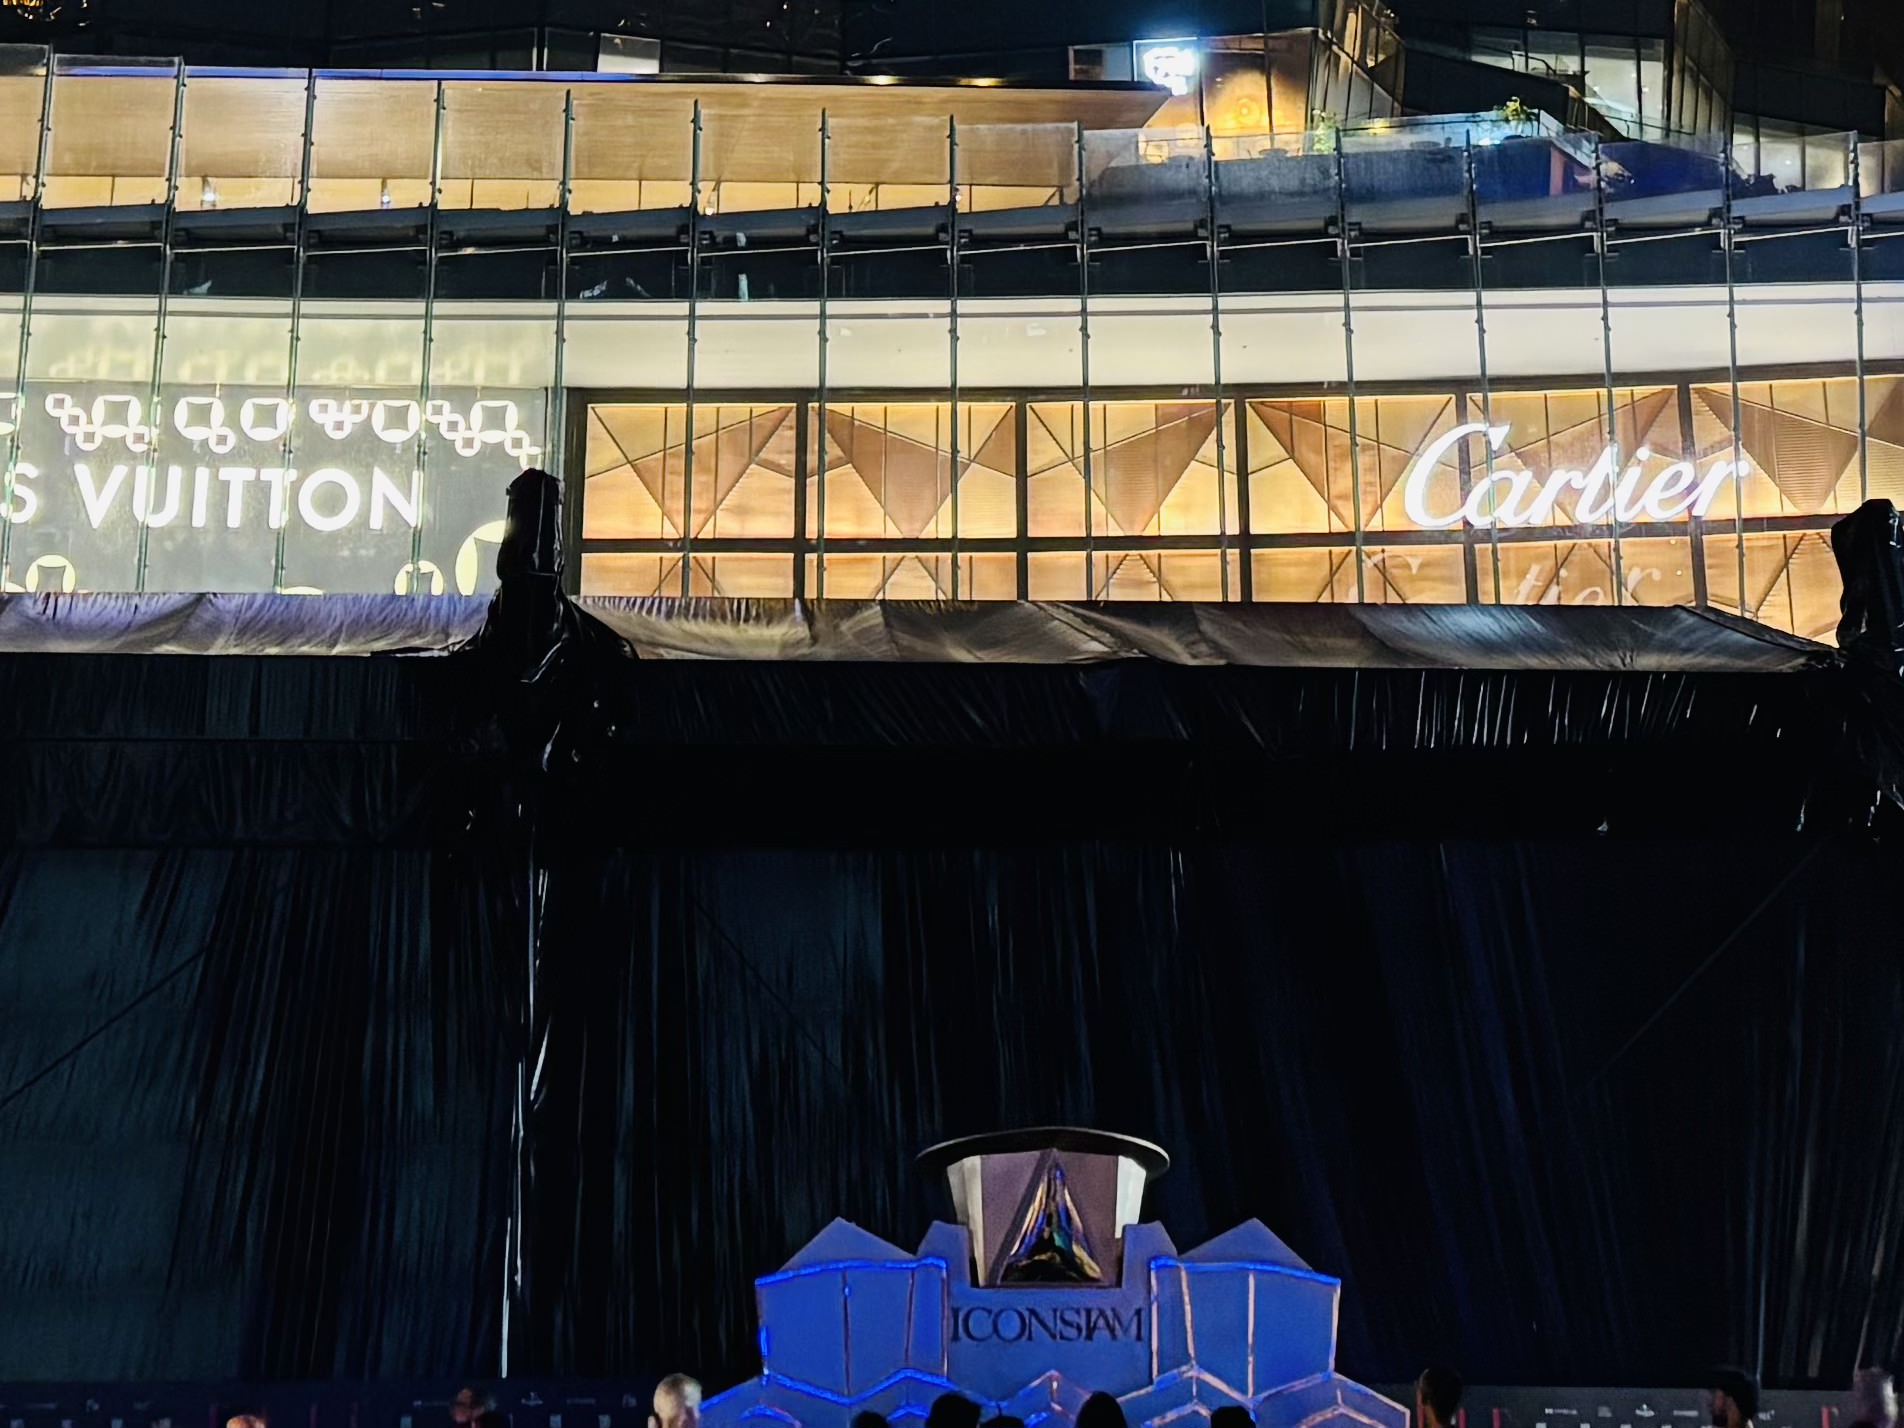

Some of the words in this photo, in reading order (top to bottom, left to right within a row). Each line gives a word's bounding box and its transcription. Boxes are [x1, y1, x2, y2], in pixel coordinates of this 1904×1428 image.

[73, 461, 422, 531] VUITTON
[1402, 421, 1750, 529] Cartier
[950, 1306, 1145, 1343] ICONSIAM
